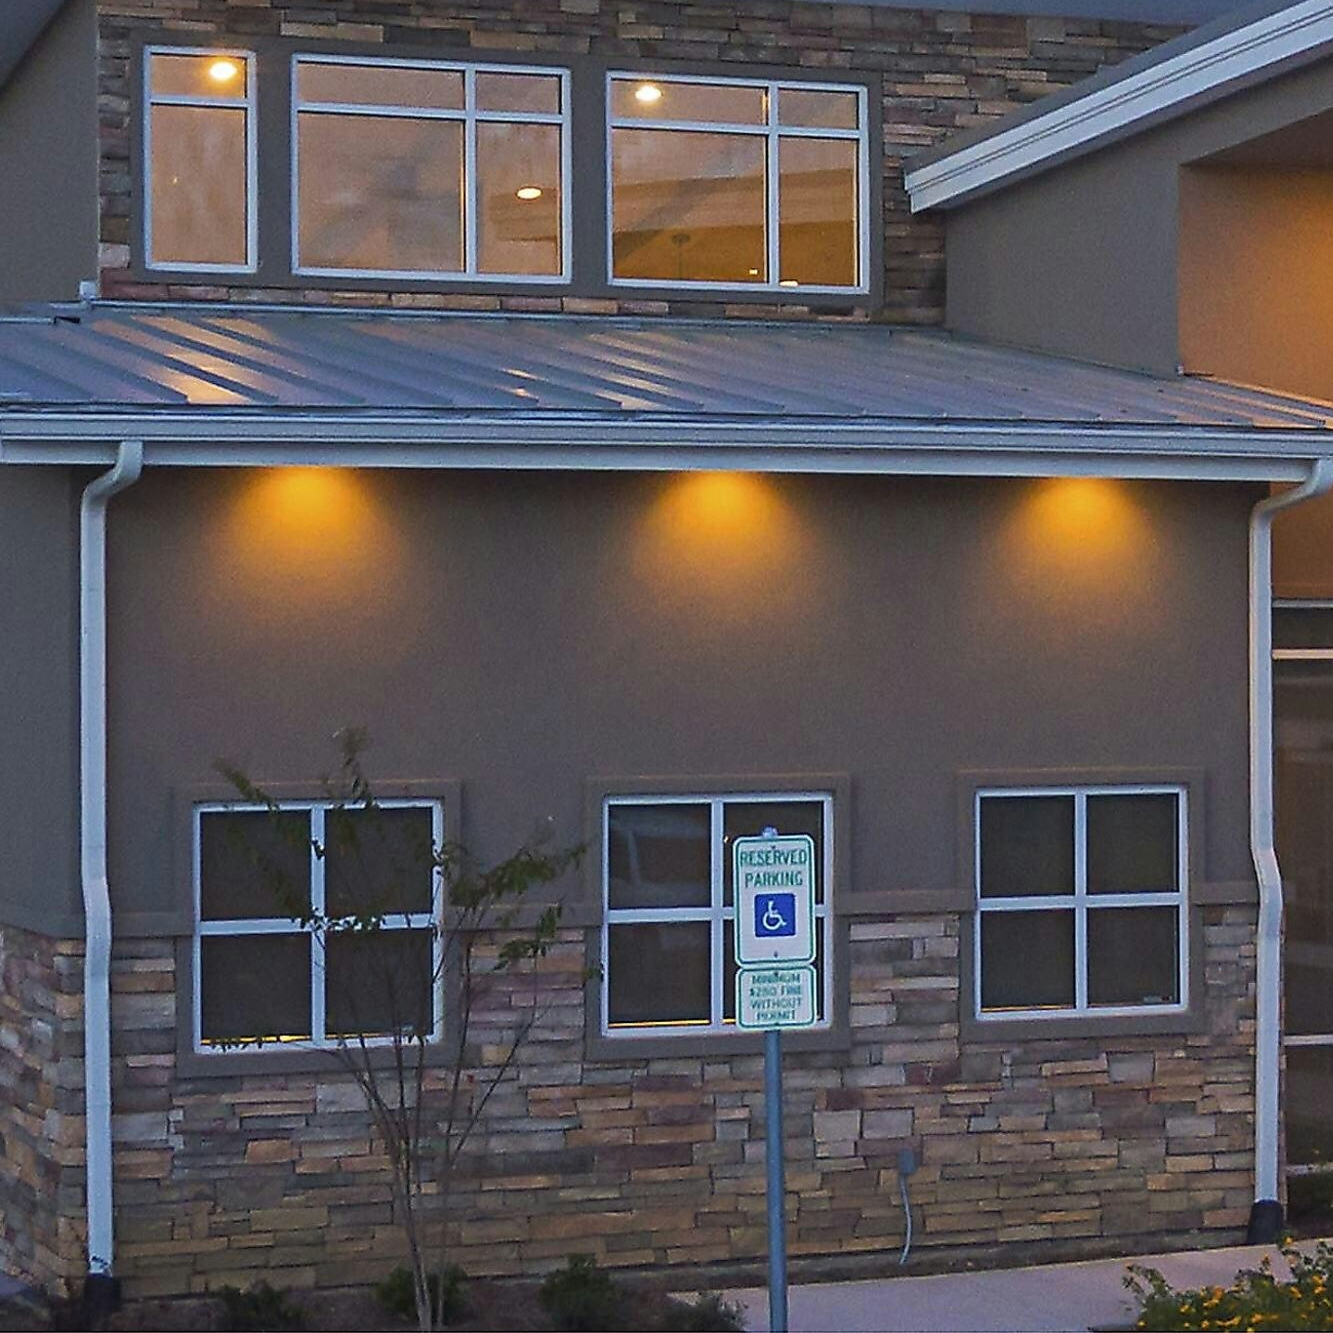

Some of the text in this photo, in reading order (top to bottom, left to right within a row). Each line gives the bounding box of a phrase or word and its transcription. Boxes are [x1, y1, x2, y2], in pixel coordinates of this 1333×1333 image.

[740, 849, 807, 867] RESERVED
[744, 871, 803, 888] PARKING
[752, 997, 801, 1009] WITHOUT
